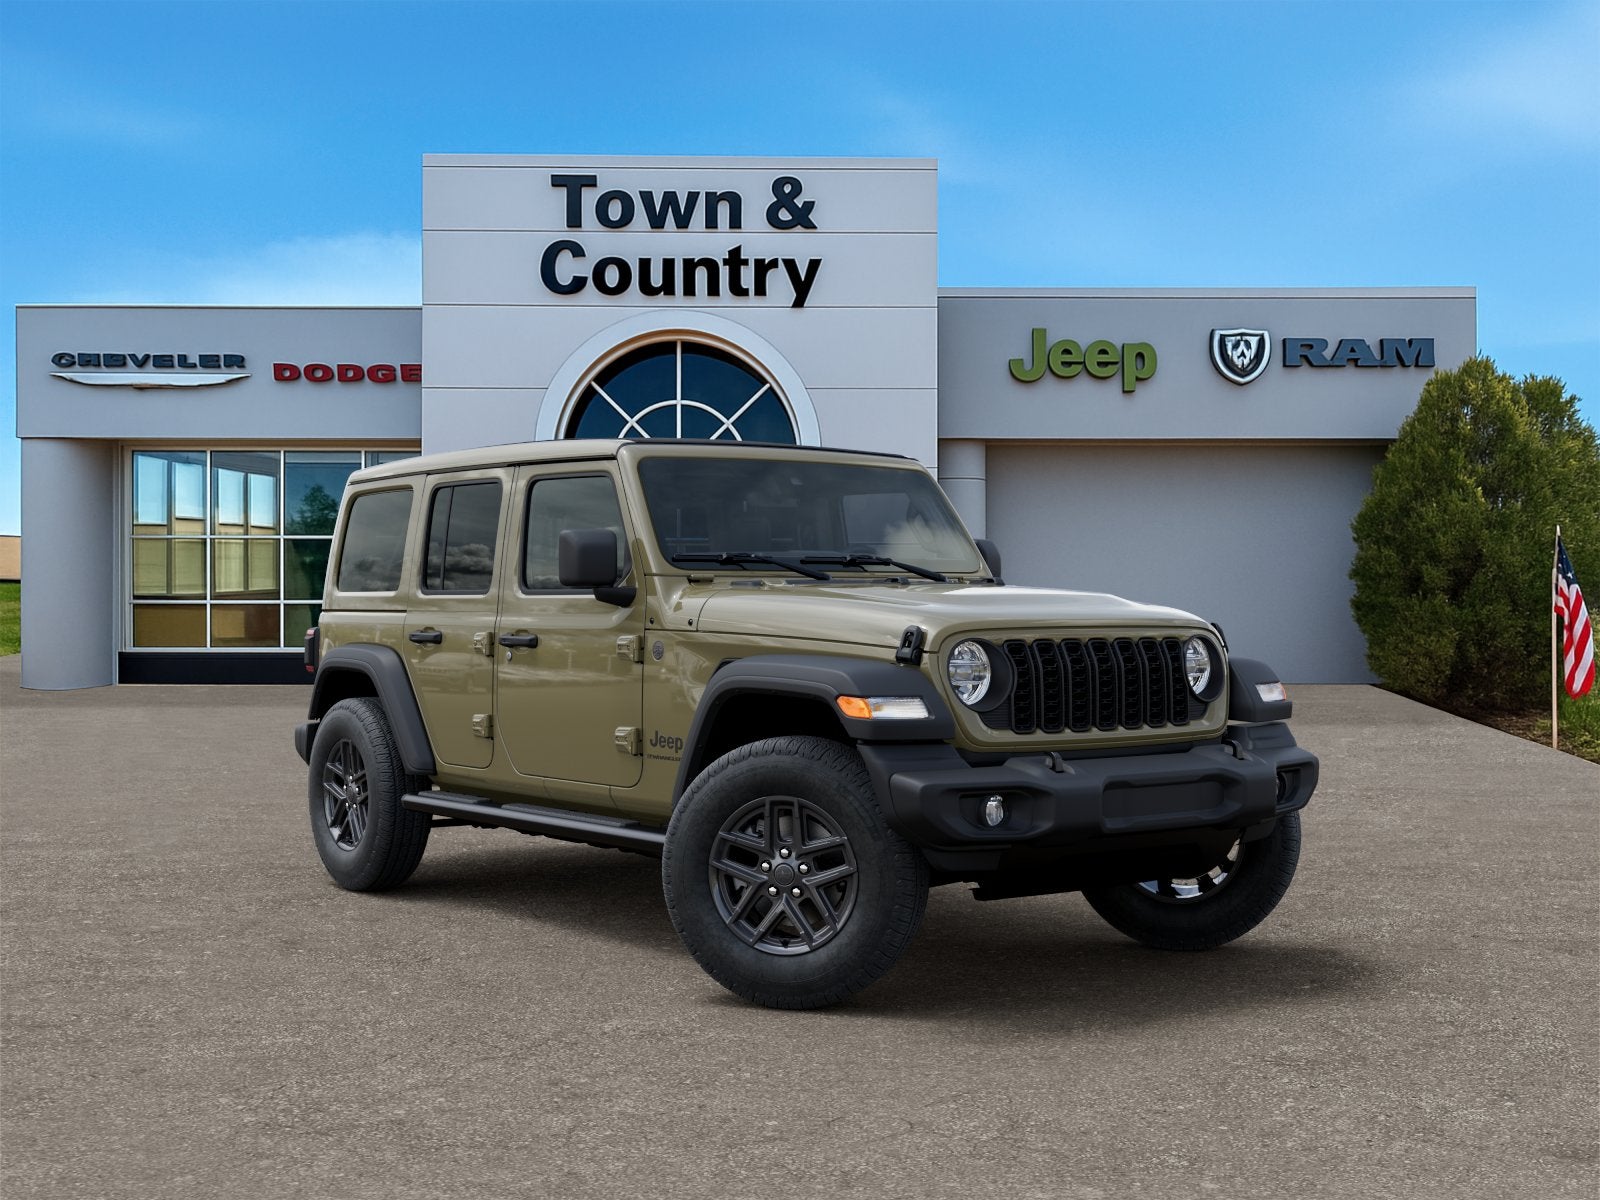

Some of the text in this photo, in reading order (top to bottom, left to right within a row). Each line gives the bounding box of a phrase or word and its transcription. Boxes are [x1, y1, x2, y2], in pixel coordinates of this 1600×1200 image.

[551, 174, 818, 230] Town &
[540, 239, 822, 308] Country
[273, 362, 422, 383] DODGE
[1008, 327, 1157, 393] Jeep
[1282, 337, 1435, 368] RAM
[649, 730, 683, 753] Jeep
